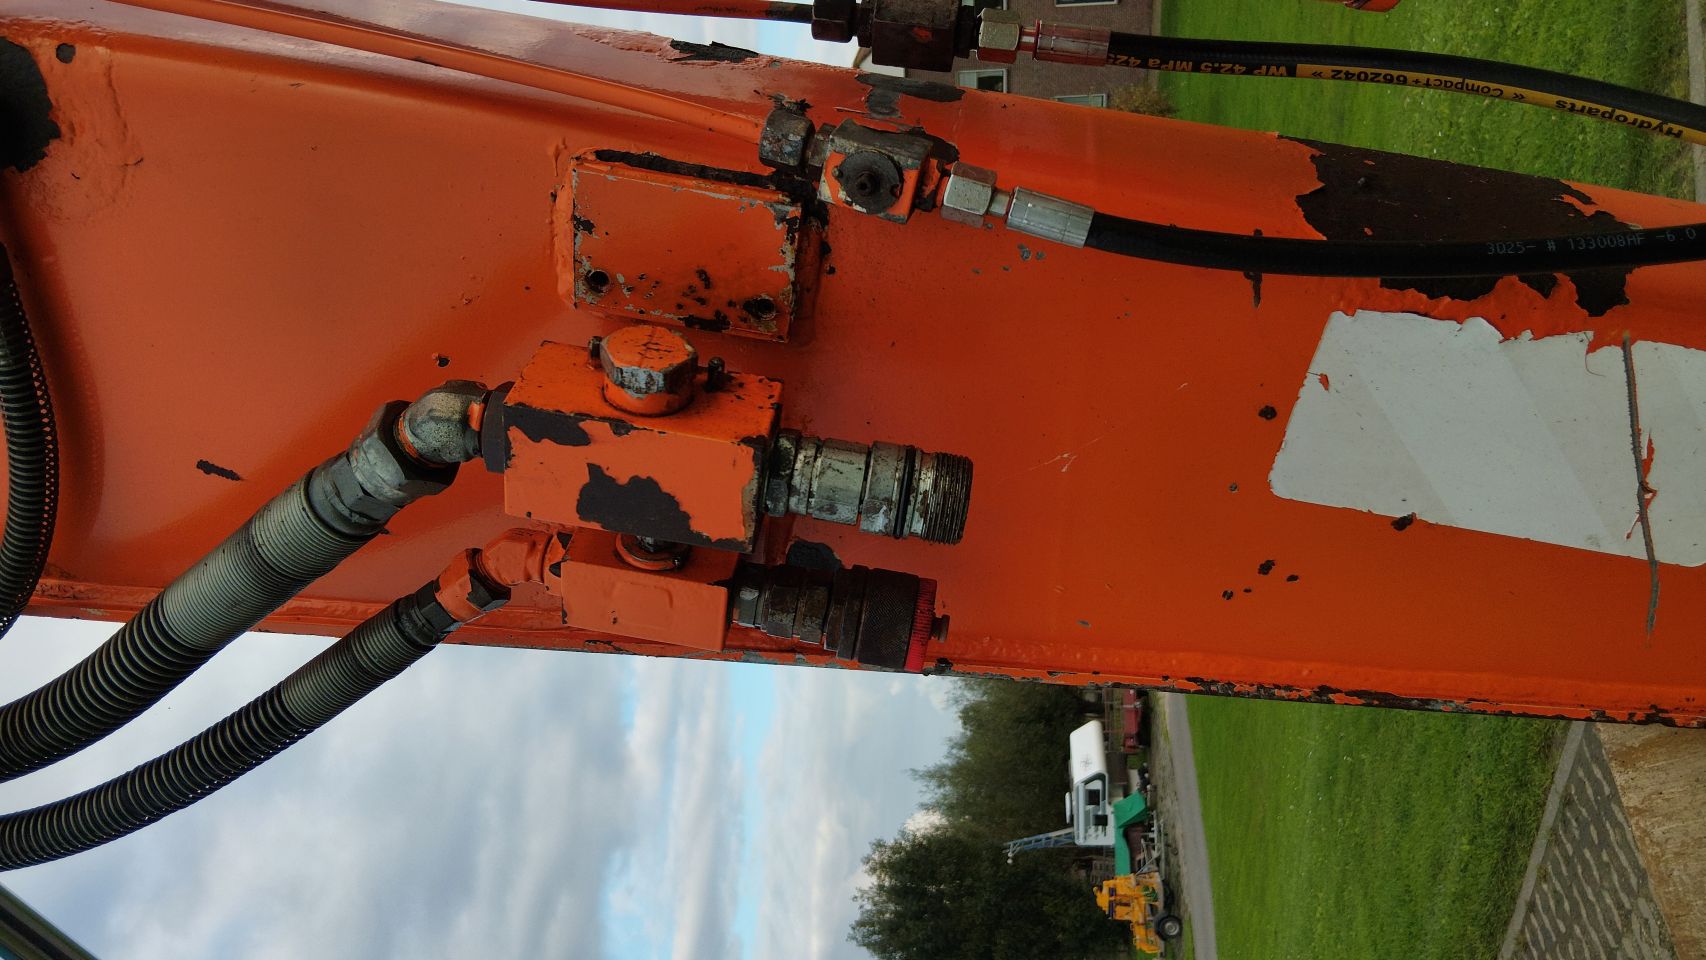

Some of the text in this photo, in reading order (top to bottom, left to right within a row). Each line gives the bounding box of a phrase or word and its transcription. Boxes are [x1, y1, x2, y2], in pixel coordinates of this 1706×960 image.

[1147, 57, 1193, 73] MPa
[1199, 61, 1247, 74] 42.5
[1252, 64, 1288, 76] WP
[1330, 69, 1408, 86] 662042
[1554, 99, 1684, 139] Hydroparts
